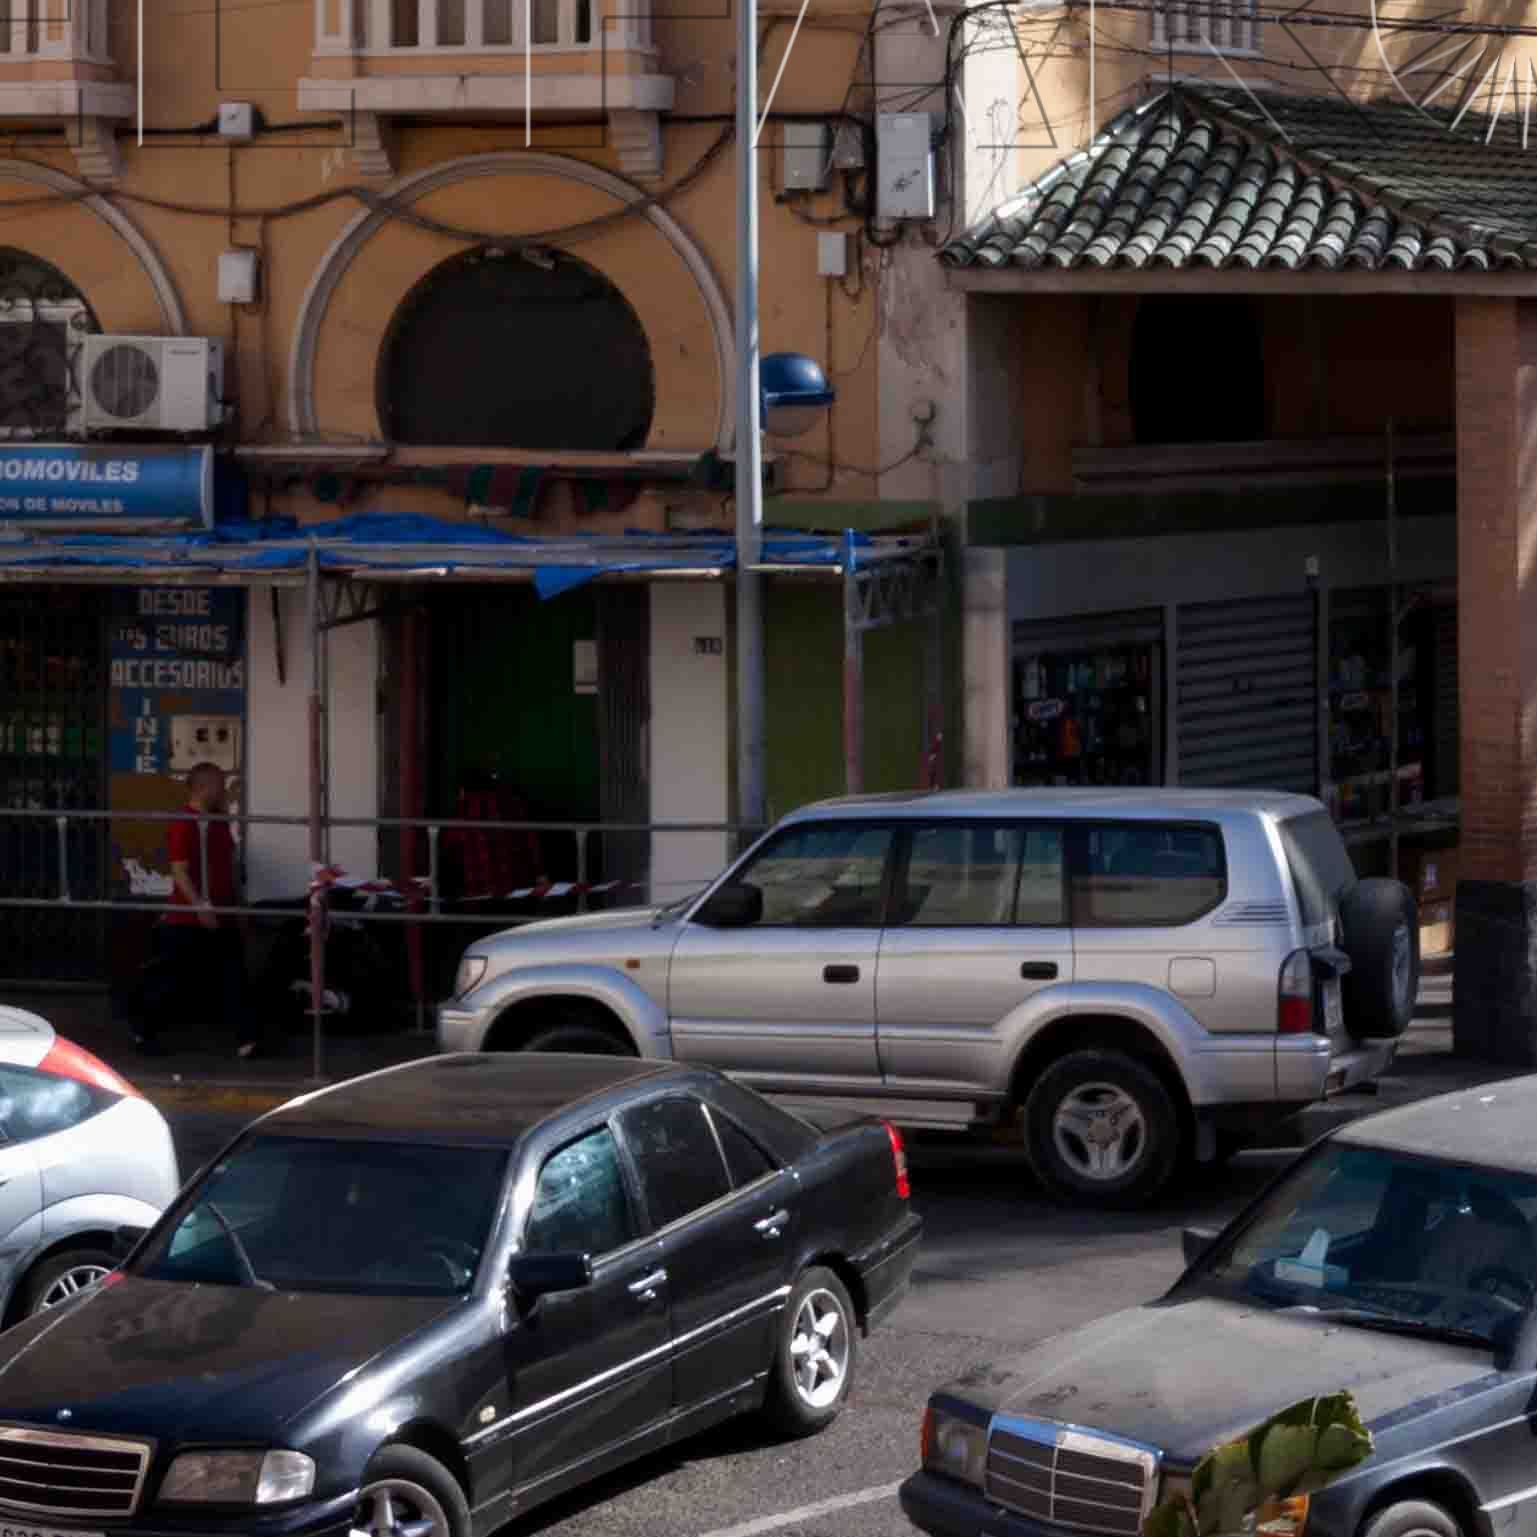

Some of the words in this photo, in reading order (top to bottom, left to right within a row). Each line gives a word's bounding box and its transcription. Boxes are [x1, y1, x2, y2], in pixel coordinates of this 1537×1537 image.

[24, 495, 47, 513] DE
[51, 496, 124, 514] MOVILES
[138, 588, 210, 616] DESDE
[156, 624, 229, 654] EUROS
